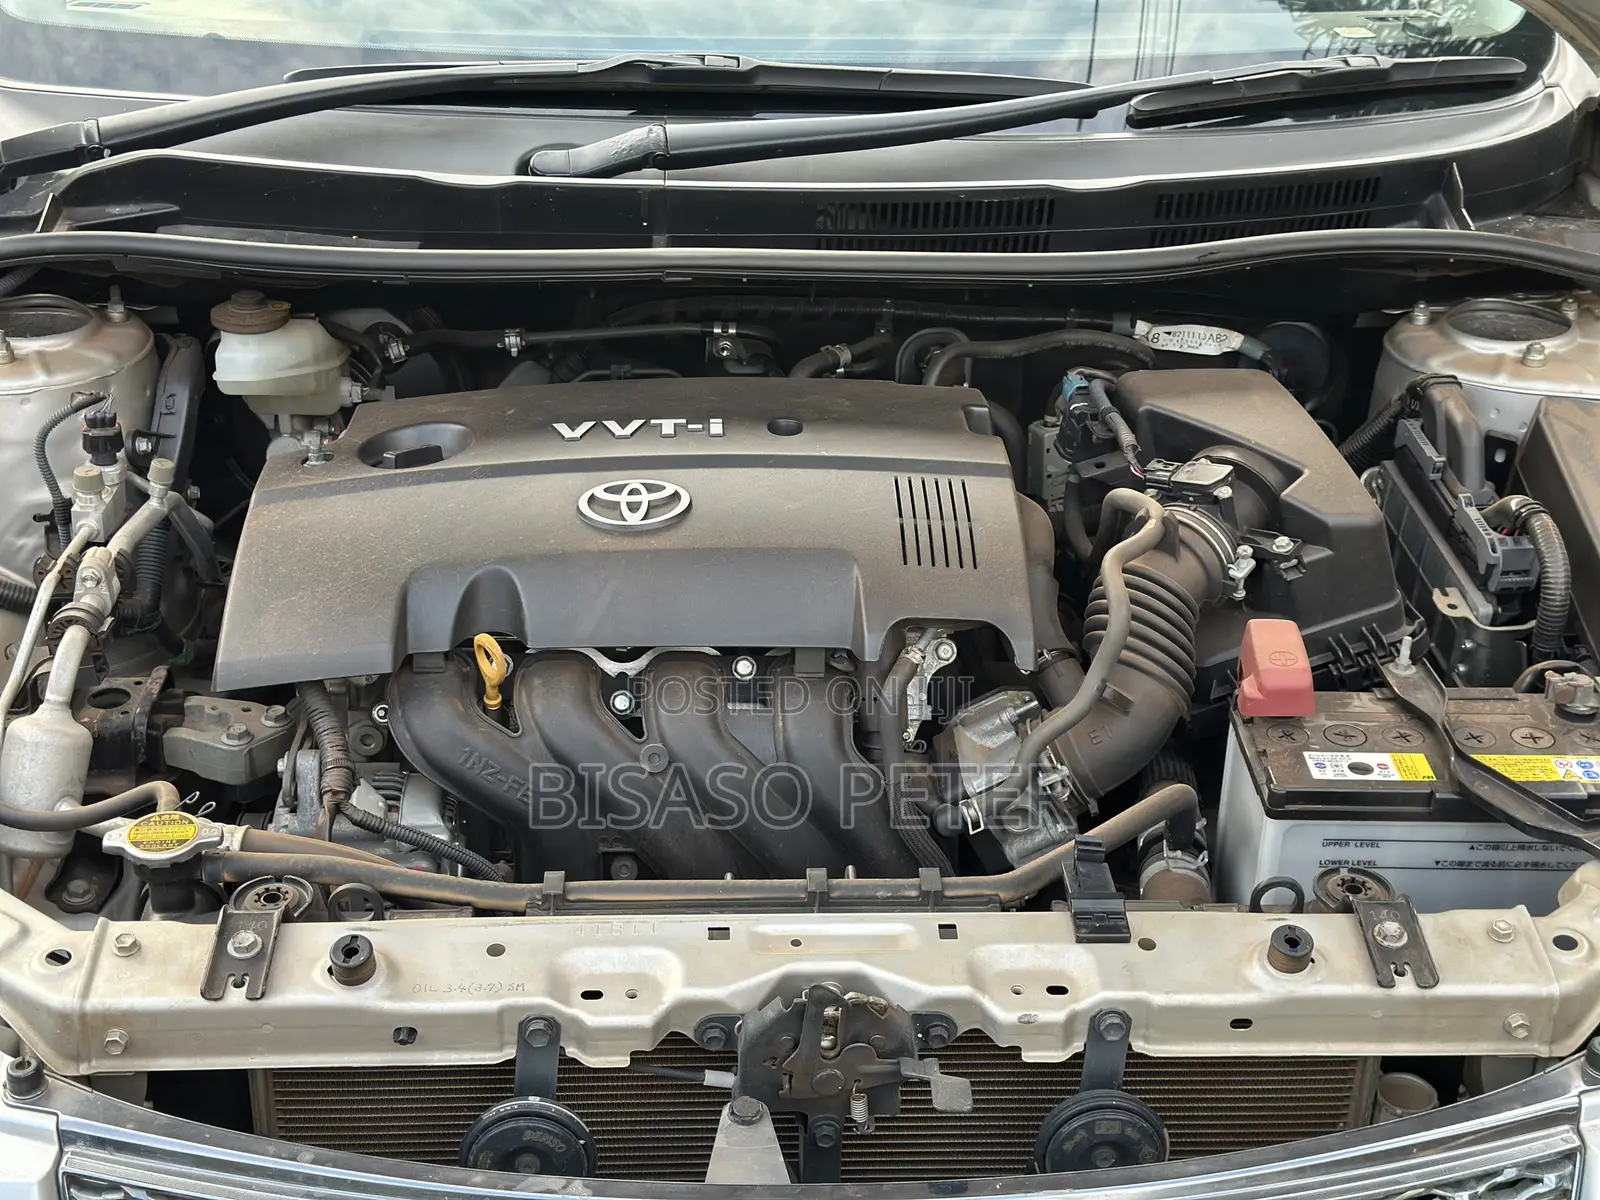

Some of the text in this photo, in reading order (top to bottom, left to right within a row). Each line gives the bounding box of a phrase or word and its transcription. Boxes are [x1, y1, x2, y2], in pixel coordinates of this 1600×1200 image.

[551, 418, 724, 442] VVT-i
[1354, 841, 1381, 849] LEVEL
[1351, 859, 1378, 867] LEVEL
